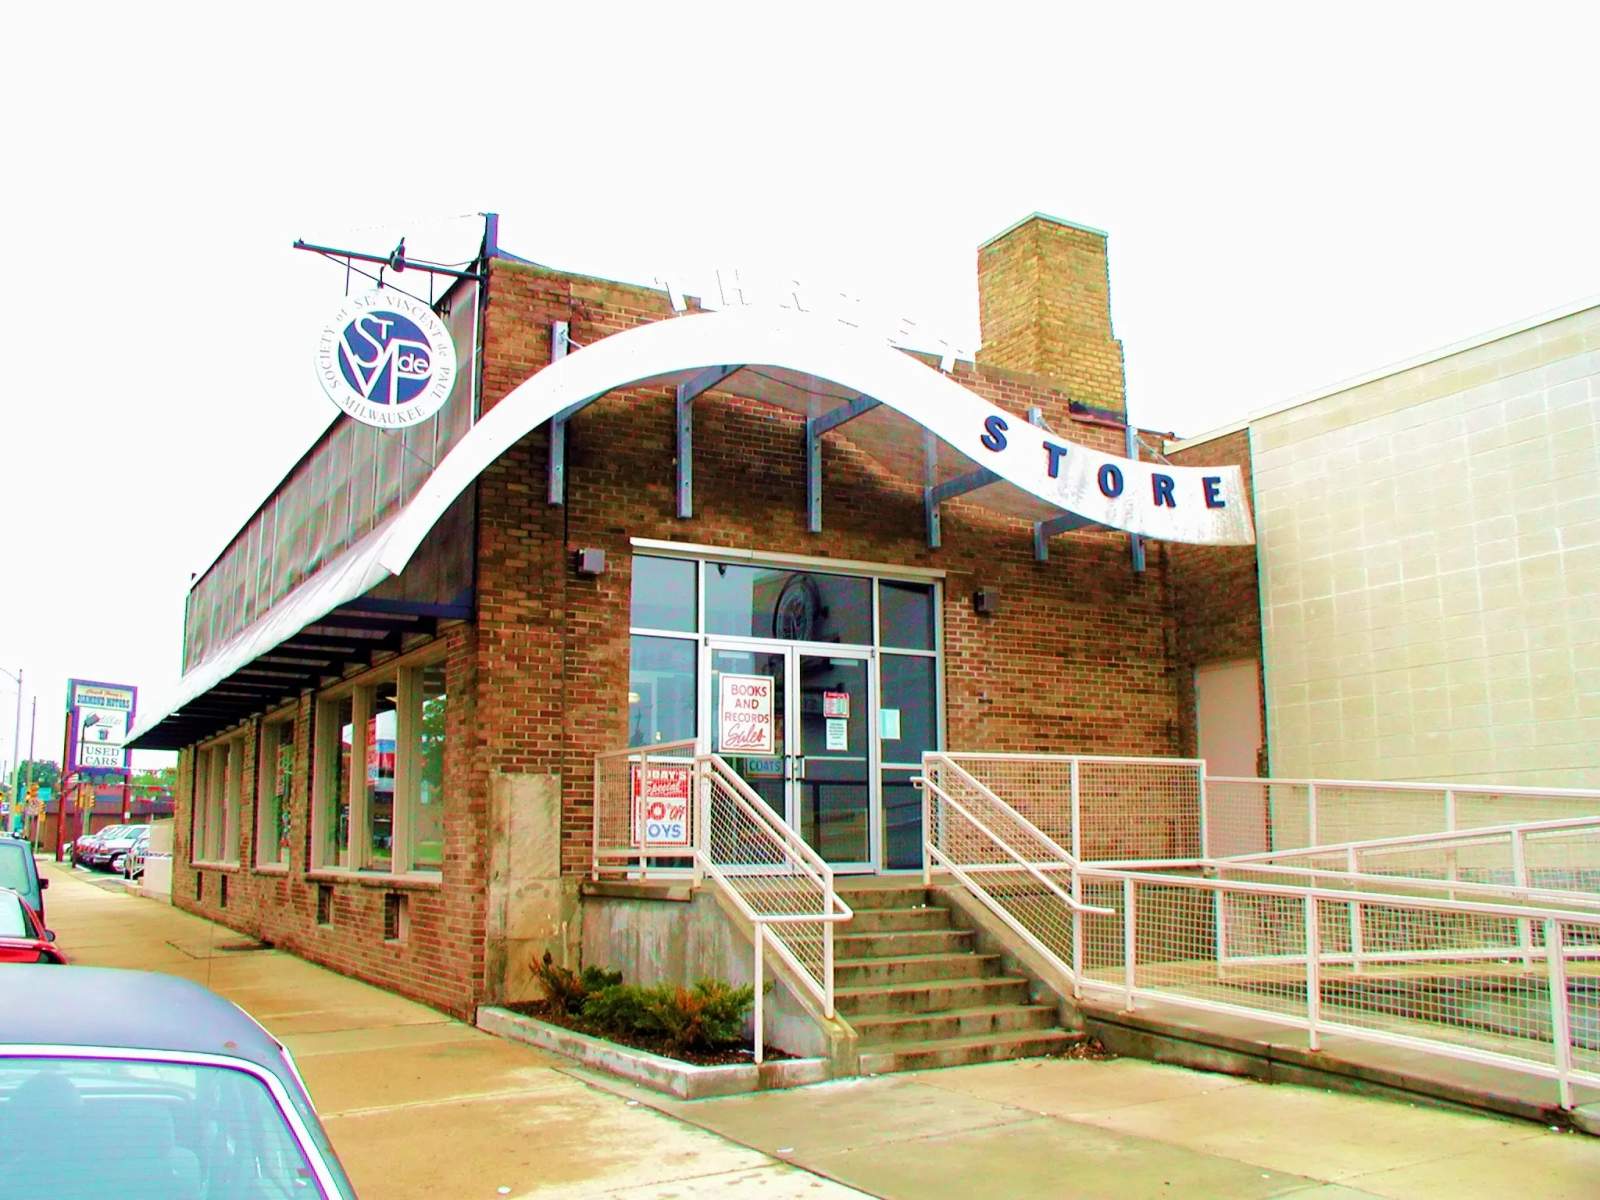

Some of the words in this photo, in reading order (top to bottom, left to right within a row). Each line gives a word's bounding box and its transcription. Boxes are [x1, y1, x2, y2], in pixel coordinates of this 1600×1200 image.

[319, 324, 339, 389] SOCIETY
[386, 295, 442, 338] VINCENT
[431, 366, 451, 399] PAUL
[342, 395, 426, 424] MILWAUKEE
[980, 415, 1227, 510] STORE
[730, 683, 768, 698] BOOKS
[734, 698, 760, 709] AND
[724, 711, 770, 724] RECORDS
[86, 746, 120, 757] USED
[86, 756, 118, 765] CARS
[749, 759, 781, 772] COATS
[645, 823, 682, 838] OYS
